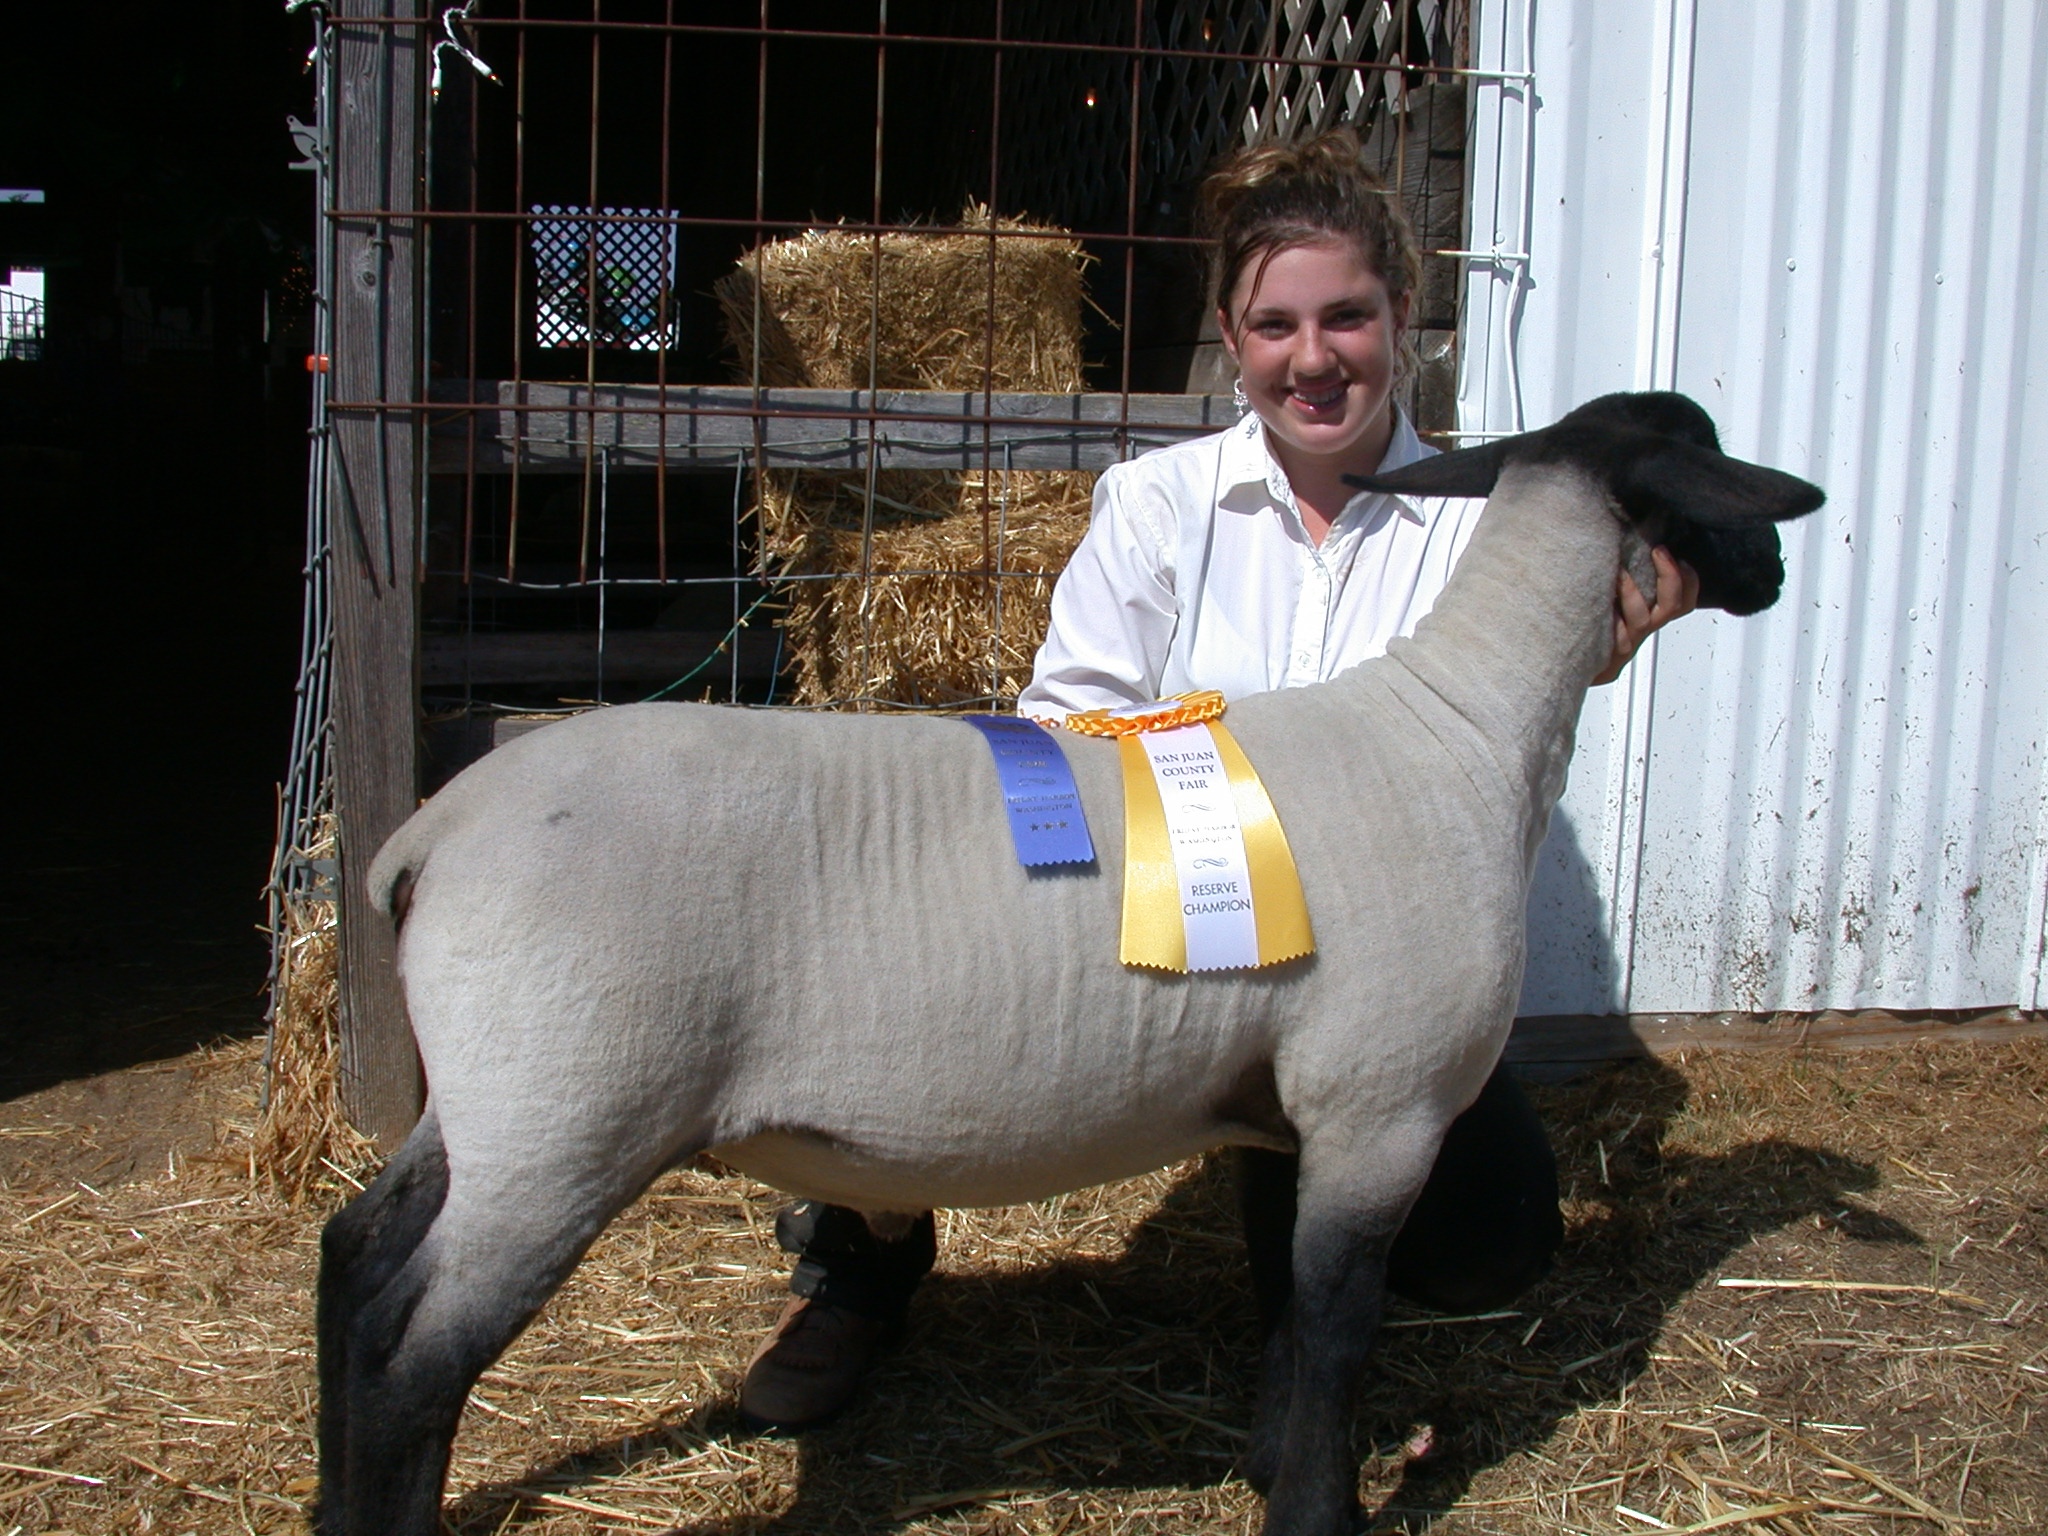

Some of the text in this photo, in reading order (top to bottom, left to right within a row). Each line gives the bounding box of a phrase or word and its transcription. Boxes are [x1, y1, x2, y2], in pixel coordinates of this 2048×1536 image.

[1154, 751, 1215, 764] SAN JUAN
[1162, 765, 1215, 777] COUNTY
[1178, 779, 1209, 790] FAIR
[1191, 881, 1239, 897] RESERVE
[1183, 898, 1251, 916] CHAMPION
